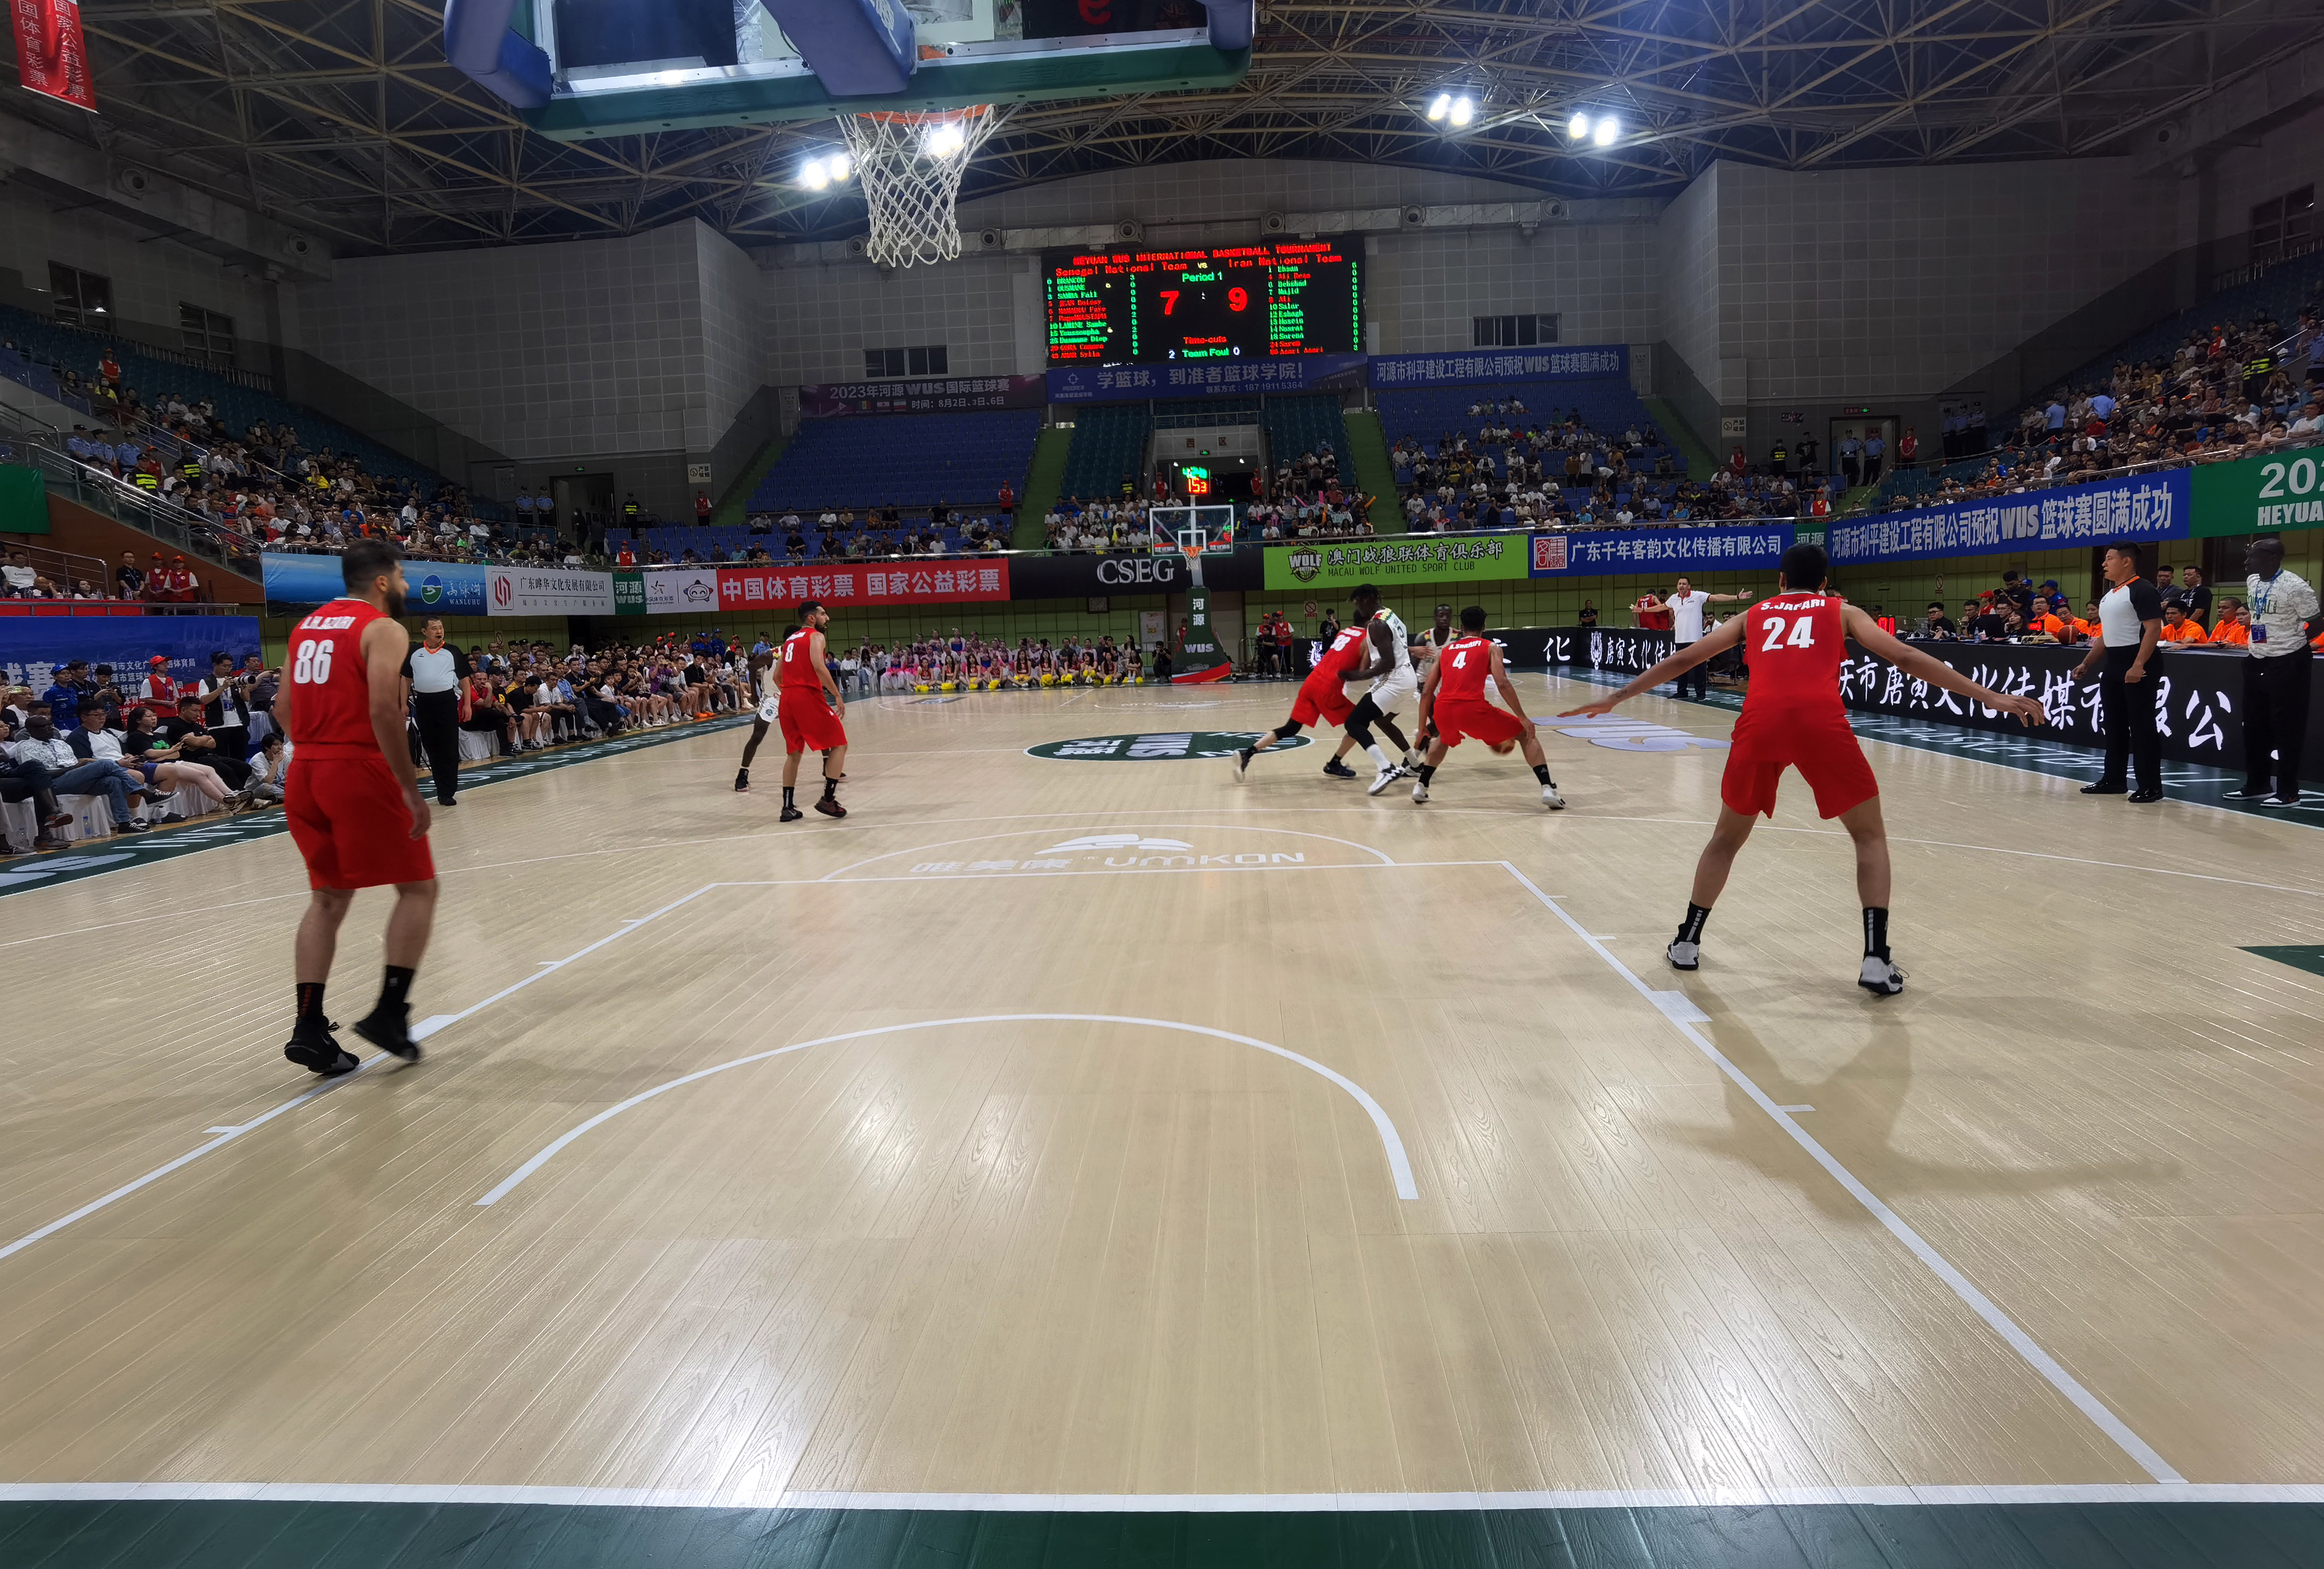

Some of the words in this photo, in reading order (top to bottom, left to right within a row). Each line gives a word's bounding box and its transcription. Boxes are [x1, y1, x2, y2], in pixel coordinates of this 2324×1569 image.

[1112, 254, 1130, 263] WUS
[1213, 247, 1270, 258] BASKETBALL
[1229, 258, 1253, 268] Iran
[1258, 255, 1308, 266] National
[1316, 254, 1342, 263] Team
[1105, 262, 1154, 274] National
[1161, 262, 1187, 271] Team
[1182, 272, 1215, 283] Period
[1218, 271, 1223, 280] 1
[1160, 290, 1179, 315] 7
[1228, 287, 1247, 312] 9
[1169, 349, 1175, 359] 2
[1182, 349, 1207, 358] Team
[1209, 347, 1229, 357] Foul
[1233, 346, 1240, 355] 0
[2259, 458, 2324, 499] 20
[2257, 500, 2324, 526] HEYUA
[1327, 540, 1503, 566] 澳门战狼联体育俱乐部
[1571, 535, 1781, 562] 广东千年客韵文化传播有限公司
[1288, 554, 1322, 568] WOLF
[1328, 567, 1354, 577] MACAU
[1359, 566, 1380, 575] WOLF
[1385, 564, 1417, 574] UNITED
[1422, 562, 1448, 573] SPORT
[1454, 561, 1475, 571] CLUB
[1097, 559, 1174, 584] CSEG
[615, 581, 642, 594] 河源
[723, 573, 854, 601] 中国体育彩票
[867, 568, 1000, 596] 国家公益彩票
[1193, 598, 1205, 626] 河源
[1761, 599, 1825, 610] S.JAFARI
[1762, 616, 1815, 652] 24
[785, 642, 794, 662] 8
[1184, 643, 1214, 653] WUS
[294, 639, 334, 684] 86
[1452, 651, 1466, 669] 4
